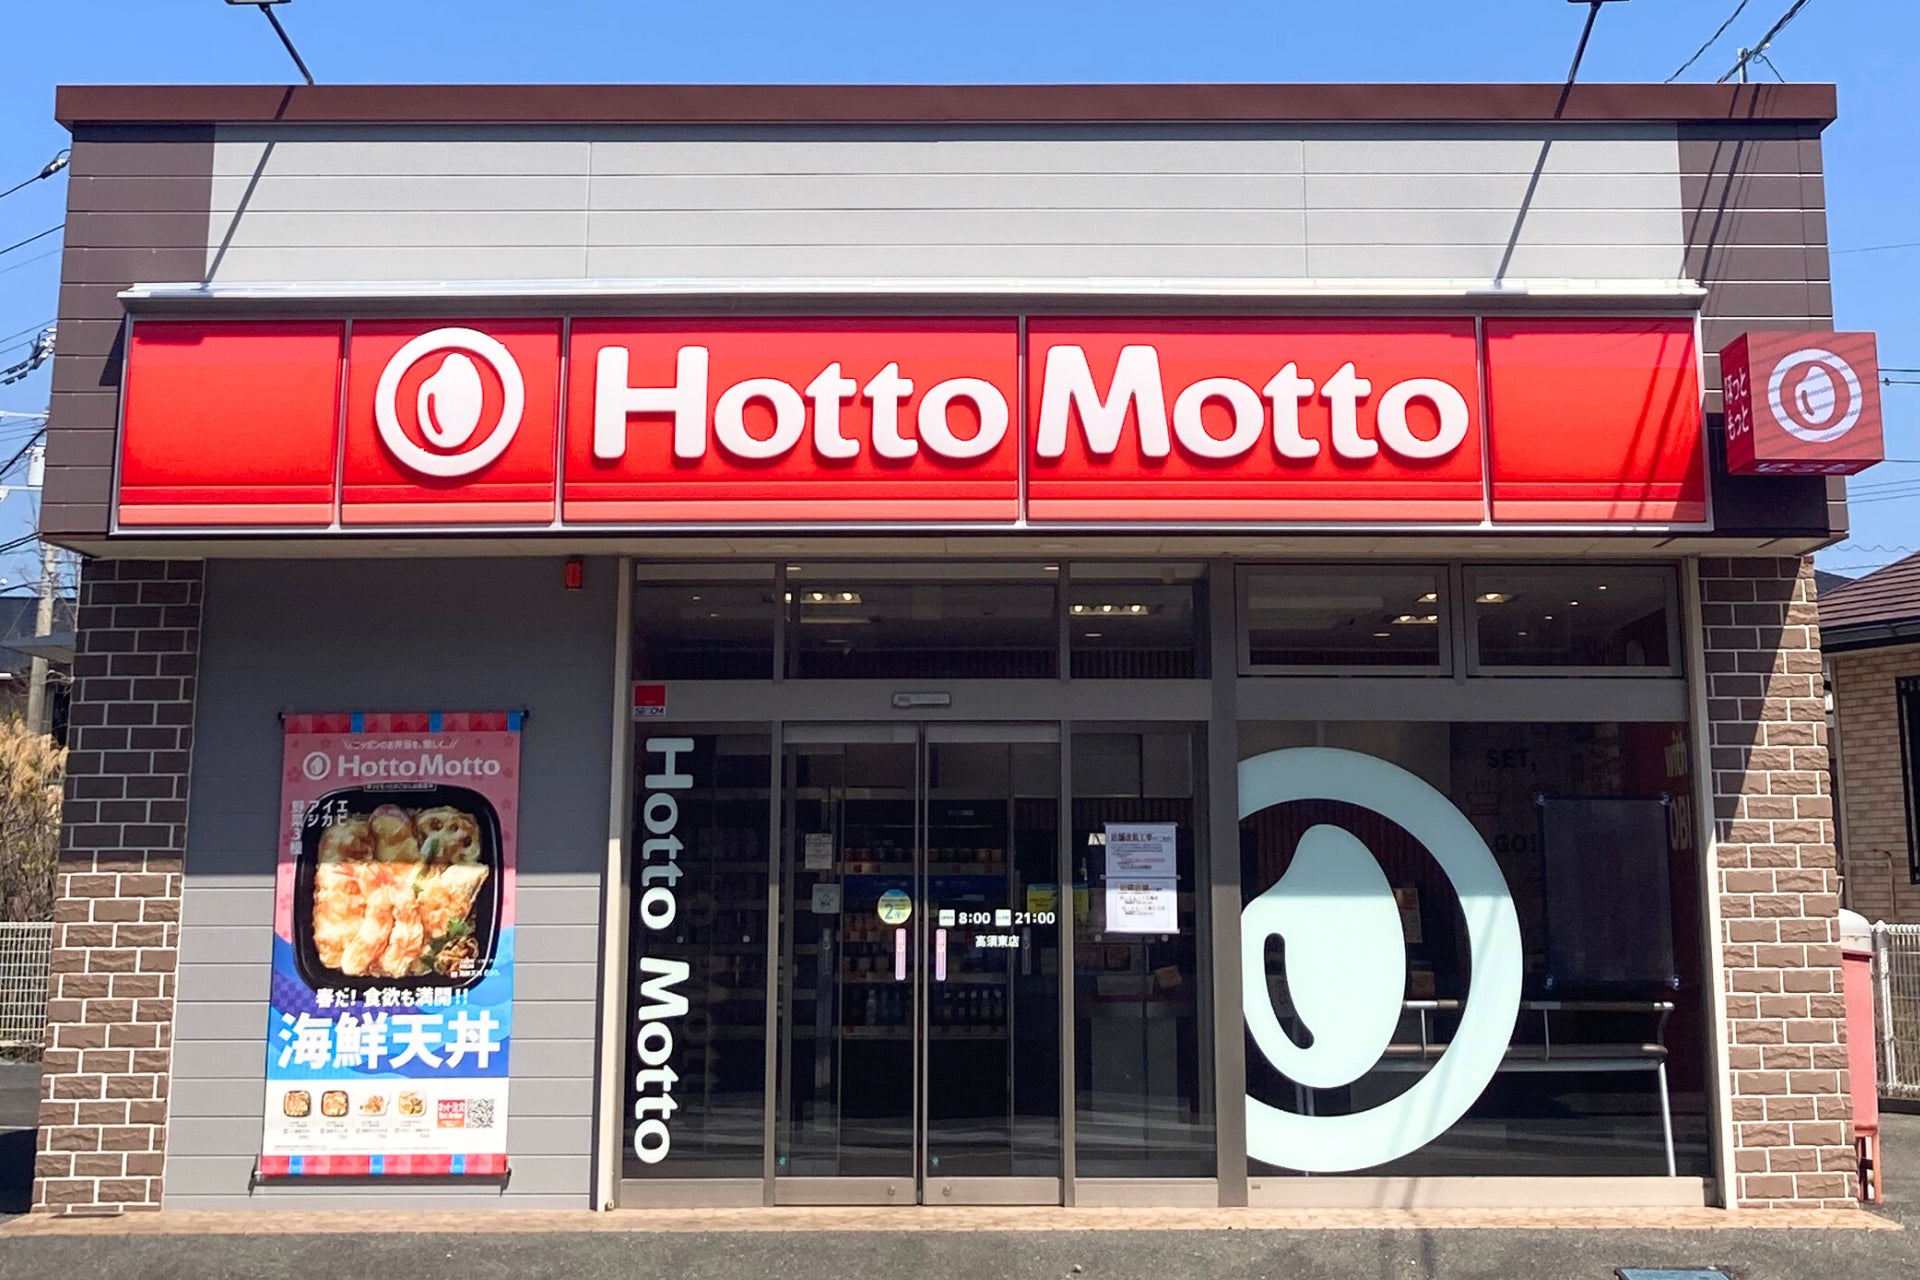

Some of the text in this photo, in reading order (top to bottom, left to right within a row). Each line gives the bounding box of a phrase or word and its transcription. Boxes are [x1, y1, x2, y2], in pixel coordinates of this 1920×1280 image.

[1724, 367, 1747, 404] ほっと
[593, 344, 1470, 459] Hotto Motto
[1728, 404, 1750, 440] もっと
[338, 752, 501, 777] Hotto Motto
[307, 801, 320, 827] アジ
[321, 800, 335, 827] イカ
[337, 800, 349, 826] エビ
[958, 912, 991, 924] 8:00
[1014, 911, 1055, 924] 21:00
[634, 737, 695, 1164] Hotto Motto
[975, 935, 1020, 948] 高須東店
[277, 1010, 501, 1070] 海鮮天丼
